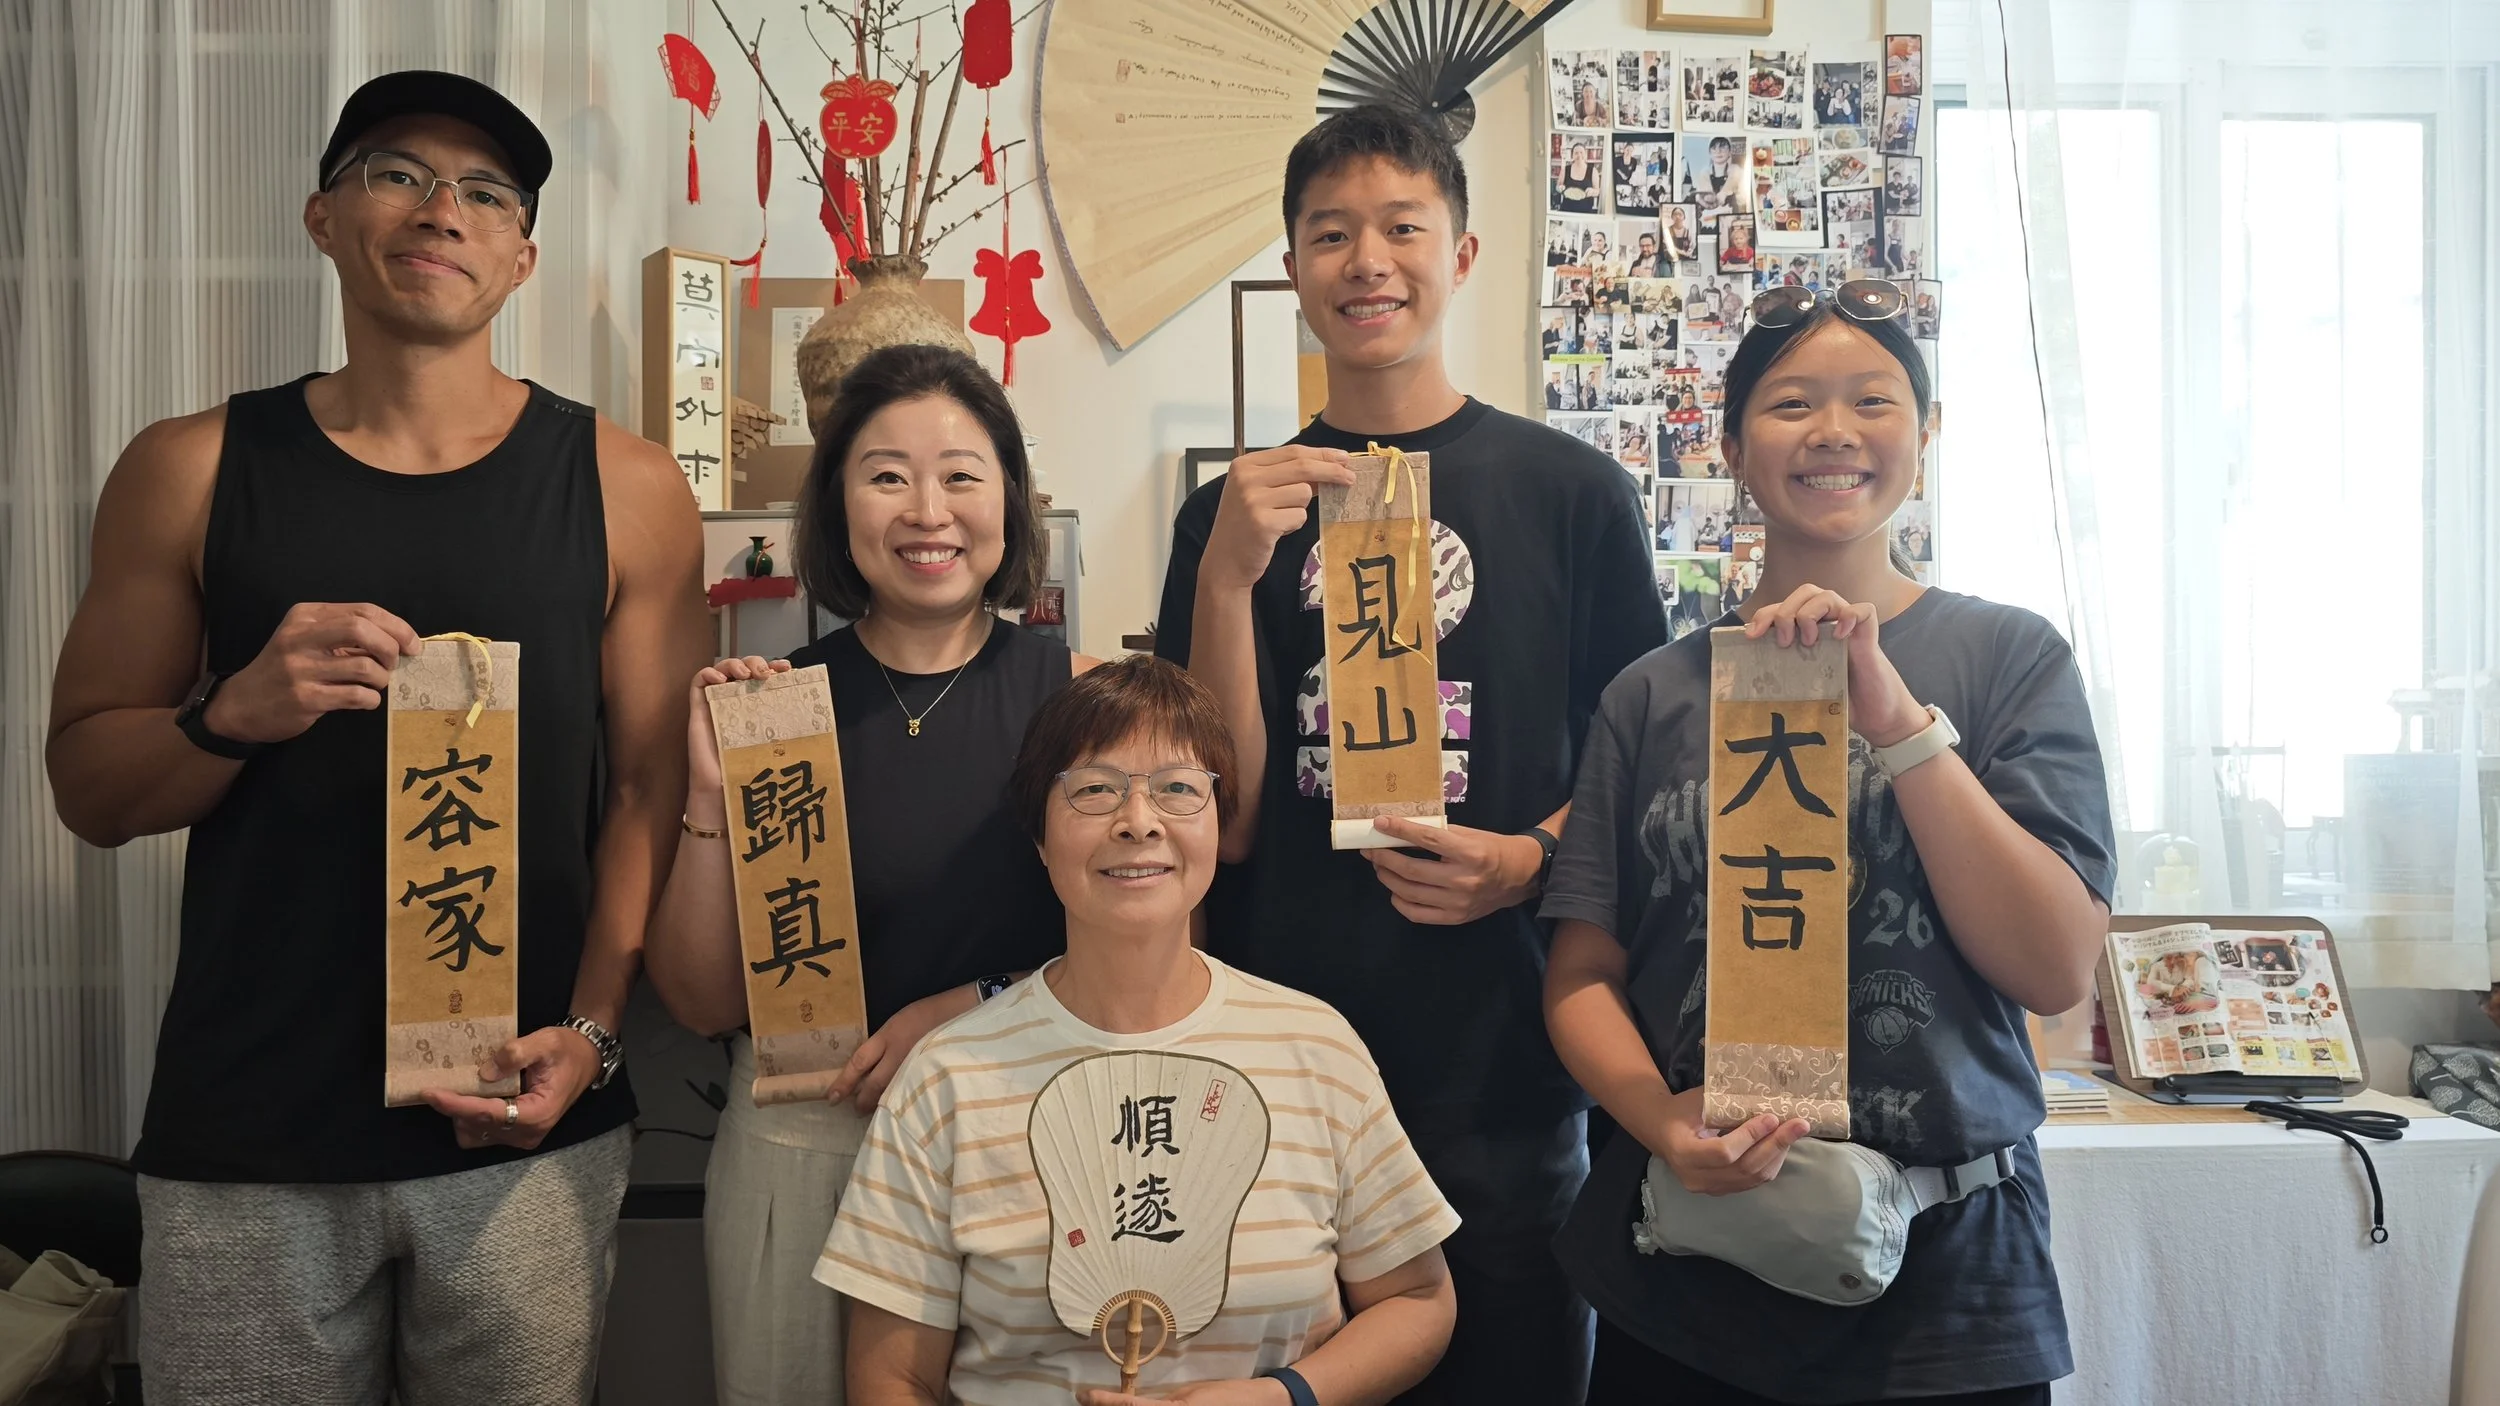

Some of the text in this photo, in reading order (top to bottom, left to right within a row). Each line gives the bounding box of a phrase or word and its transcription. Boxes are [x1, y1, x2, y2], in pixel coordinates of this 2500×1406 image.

[827, 111, 885, 146] 平安
[675, 269, 723, 485] 莫向外求
[1336, 553, 1422, 754] 見山
[396, 747, 505, 972] 容家
[740, 758, 847, 990] 歸真
[1719, 711, 1837, 952] 大吉
[1862, 887, 1935, 950] 26
[1852, 978, 1933, 1018] KNICKS
